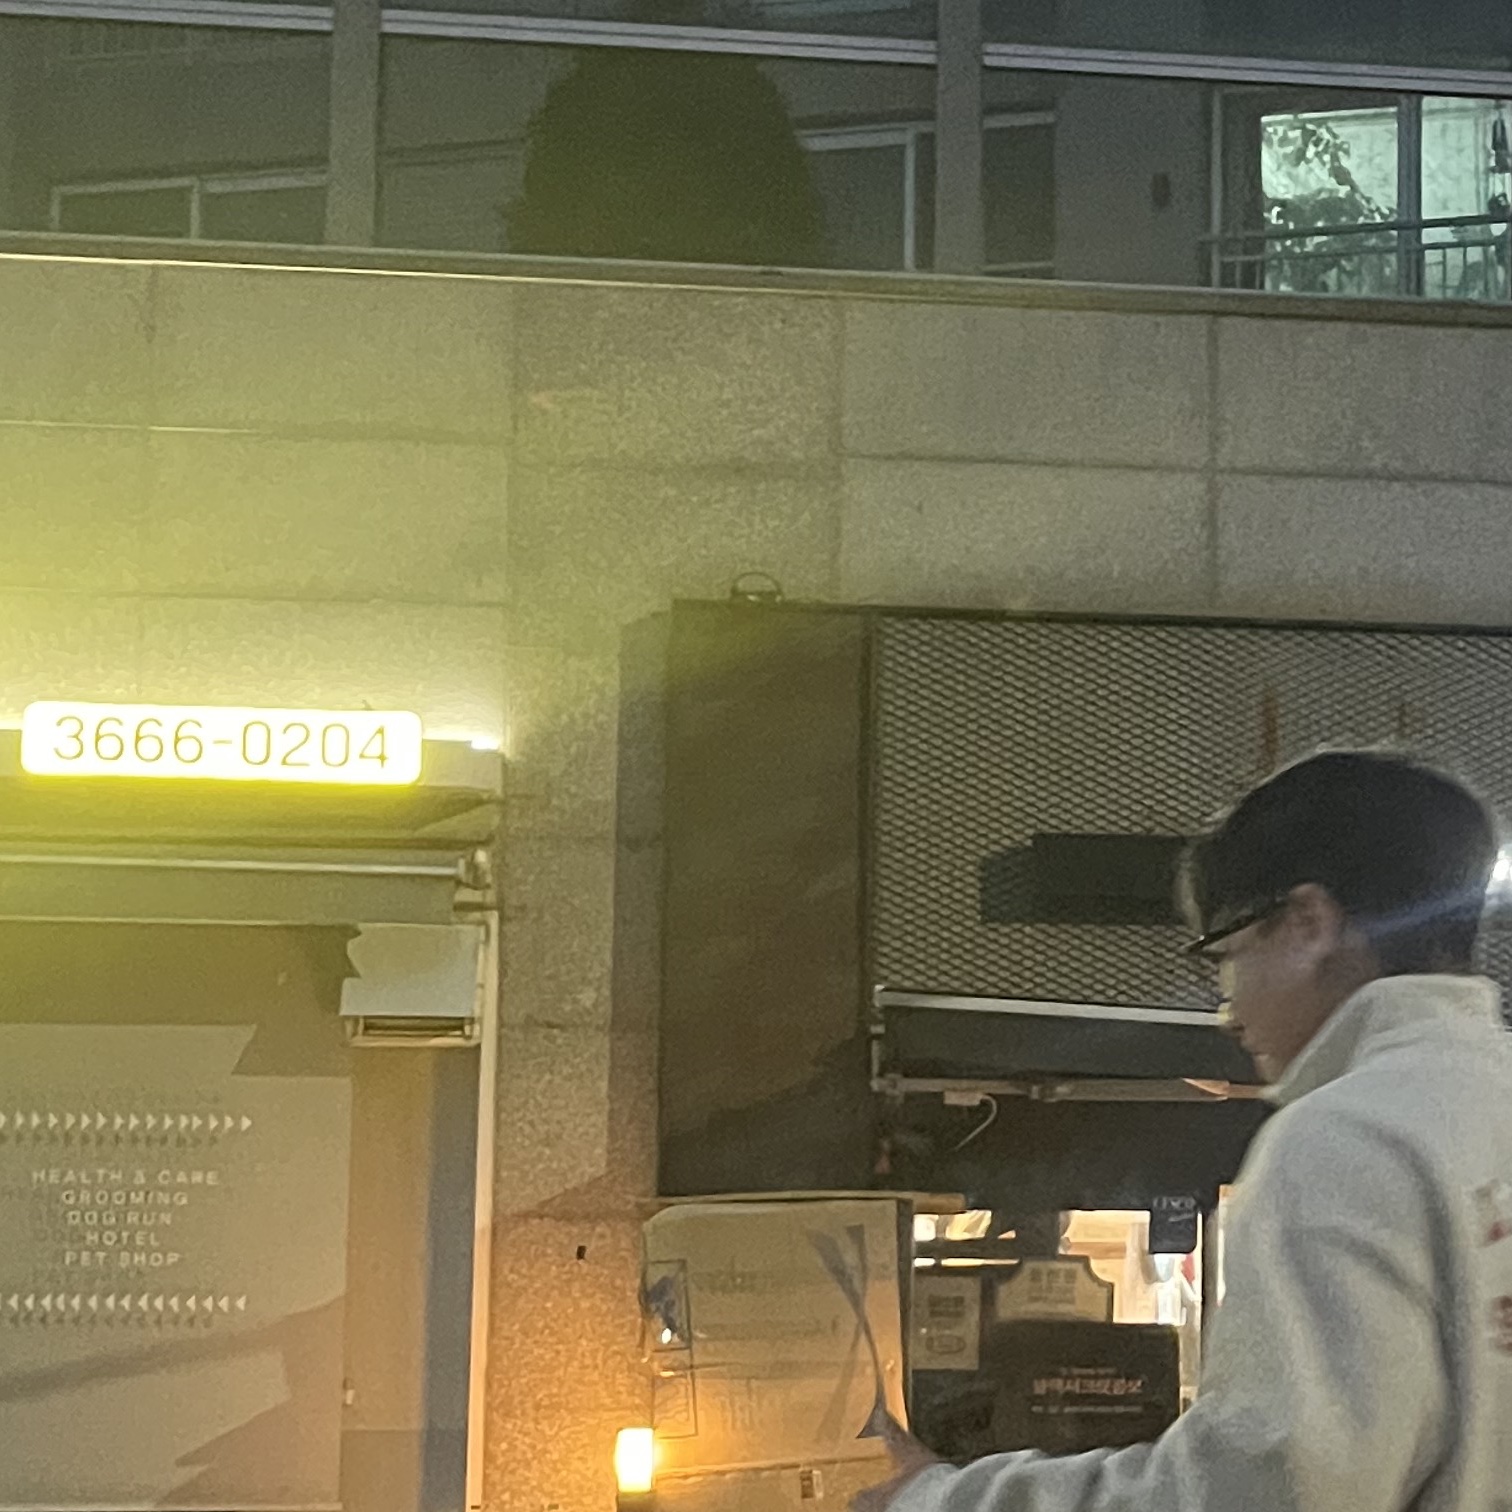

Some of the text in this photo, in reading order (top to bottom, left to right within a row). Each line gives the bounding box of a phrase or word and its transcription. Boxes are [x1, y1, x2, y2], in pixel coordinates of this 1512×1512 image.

[53, 715, 390, 769] 3666-0204
[31, 1169, 123, 1186] HEALTH
[157, 1169, 220, 1186] CARE
[61, 1189, 189, 1206] GROOMING
[67, 1210, 173, 1226] DOG RUN
[85, 1230, 160, 1246] HOTEL
[63, 1251, 109, 1267] PET
